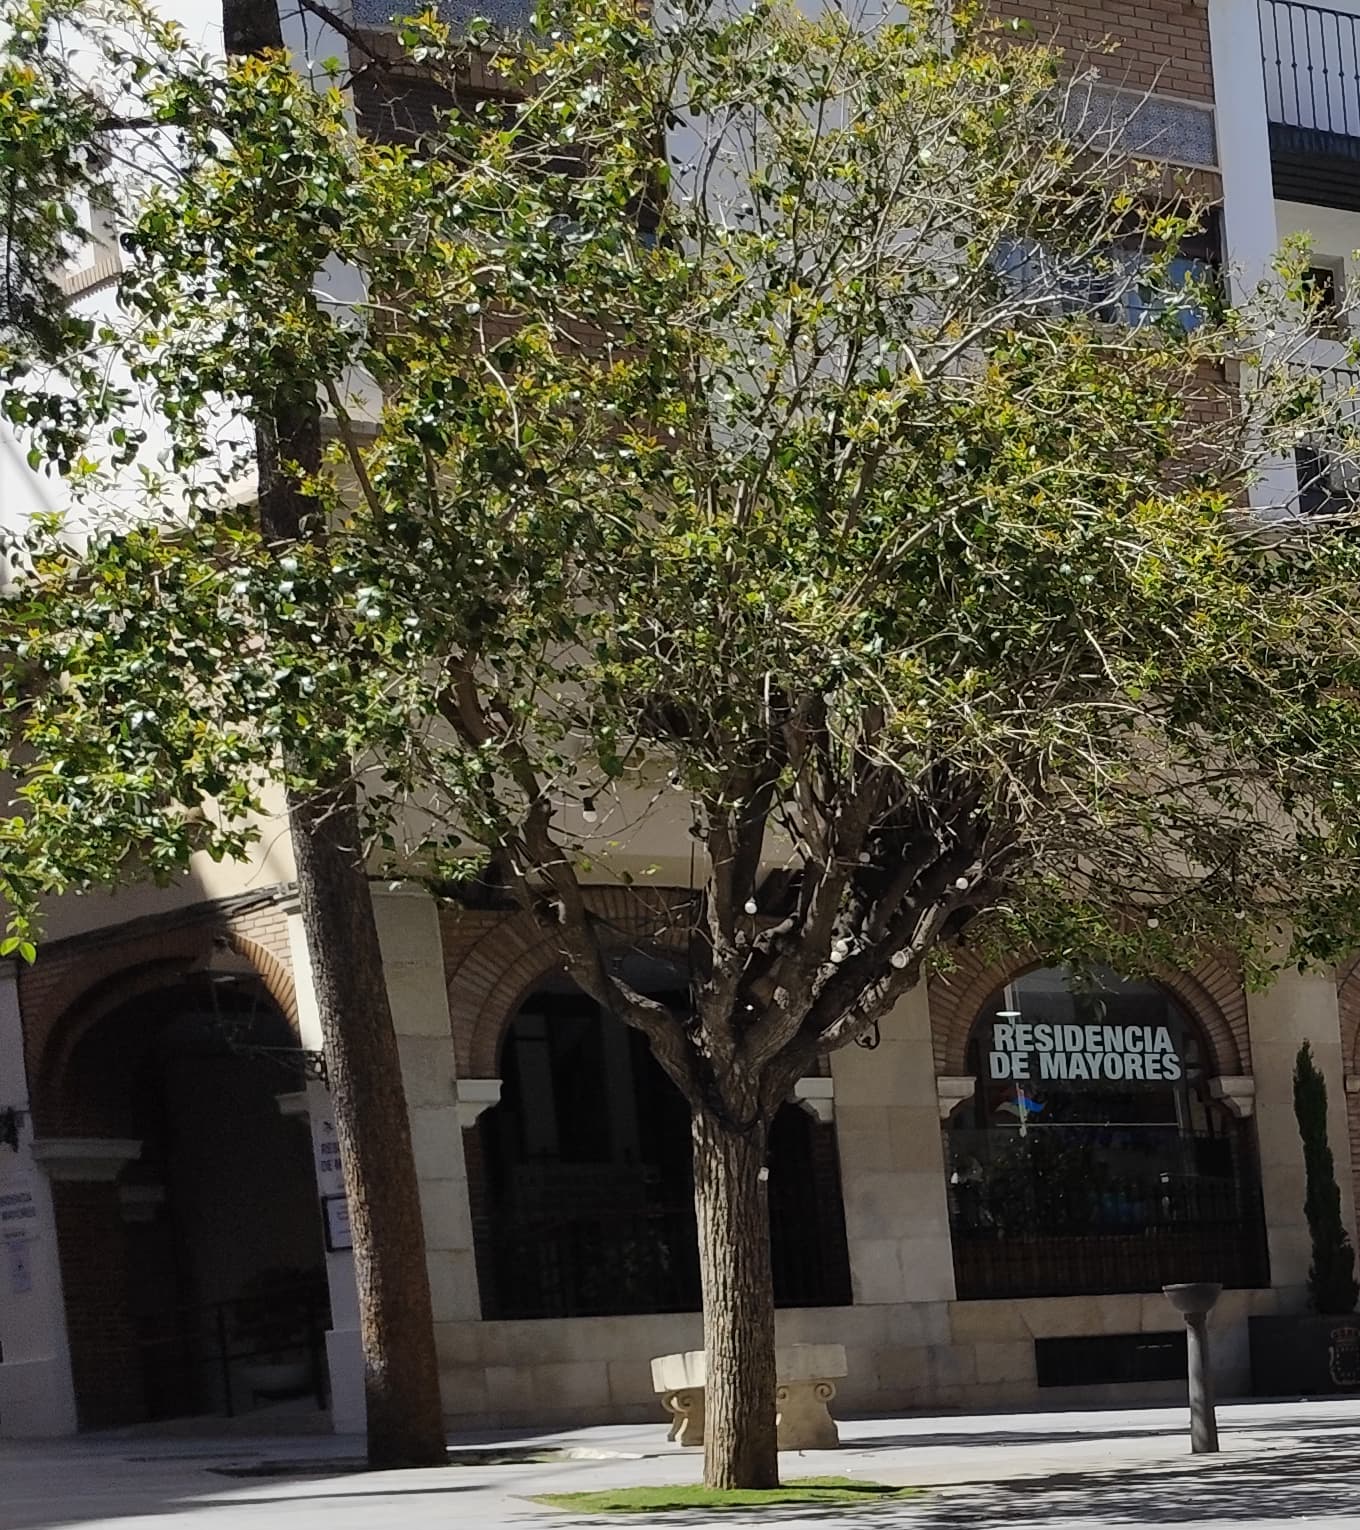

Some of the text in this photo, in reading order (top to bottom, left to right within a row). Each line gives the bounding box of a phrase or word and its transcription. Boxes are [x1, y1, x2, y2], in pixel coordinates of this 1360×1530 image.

[993, 1023, 1175, 1053] RESIDENCIA
[989, 1052, 1182, 1081] DE MAYORES
